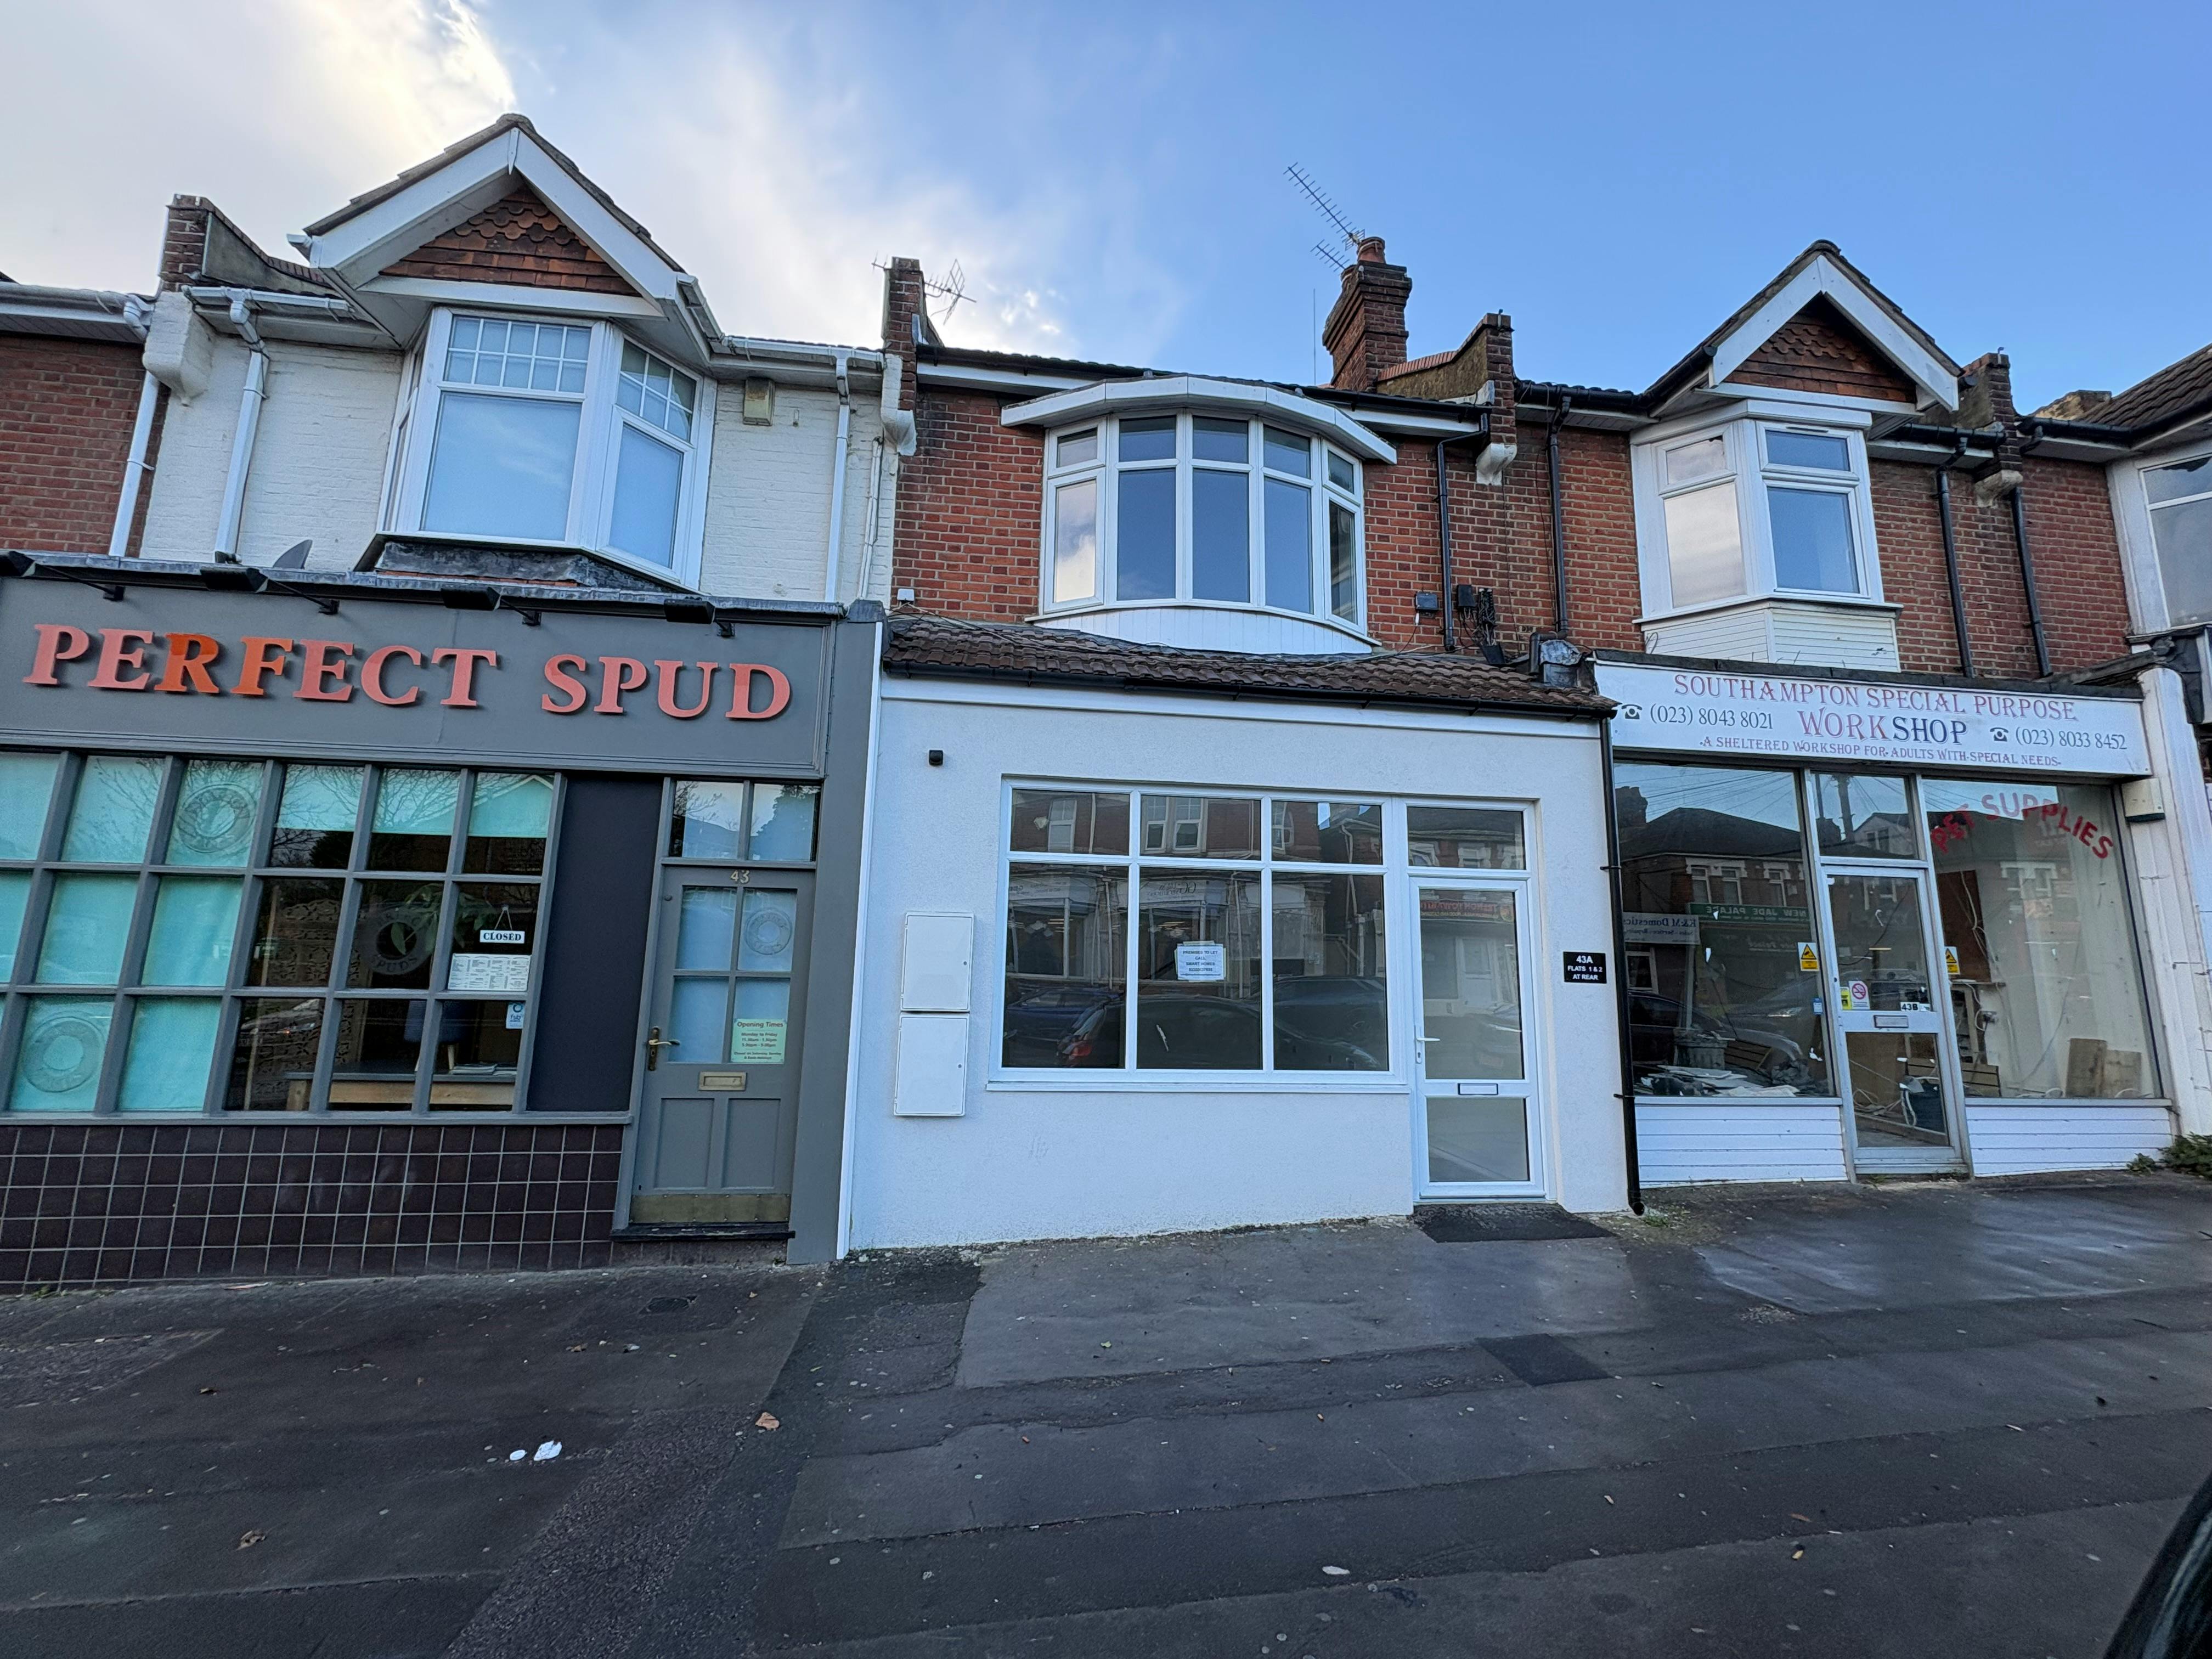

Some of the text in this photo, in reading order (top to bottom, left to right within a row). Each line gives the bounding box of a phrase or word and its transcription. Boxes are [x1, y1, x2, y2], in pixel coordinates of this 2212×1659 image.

[22, 623, 791, 720] PERFECT SPUD
[1674, 675, 2078, 721] SOUTHAMPTON SPECIAL PURPOSE
[1650, 703, 1774, 729] (023) 8043 8021
[1797, 706, 1967, 745] WORKSHOP
[1702, 736, 2058, 766] A SHELTERED WORKSHOP FOR ADULTS WITH SPECIAL NEEDS
[2016, 726, 2128, 750] (023) 8033 8452
[1930, 792, 2114, 859] PET SUPPLIES
[730, 870, 750, 884] 43
[483, 933, 521, 941] CLOSED
[1576, 955, 1594, 963] 43A
